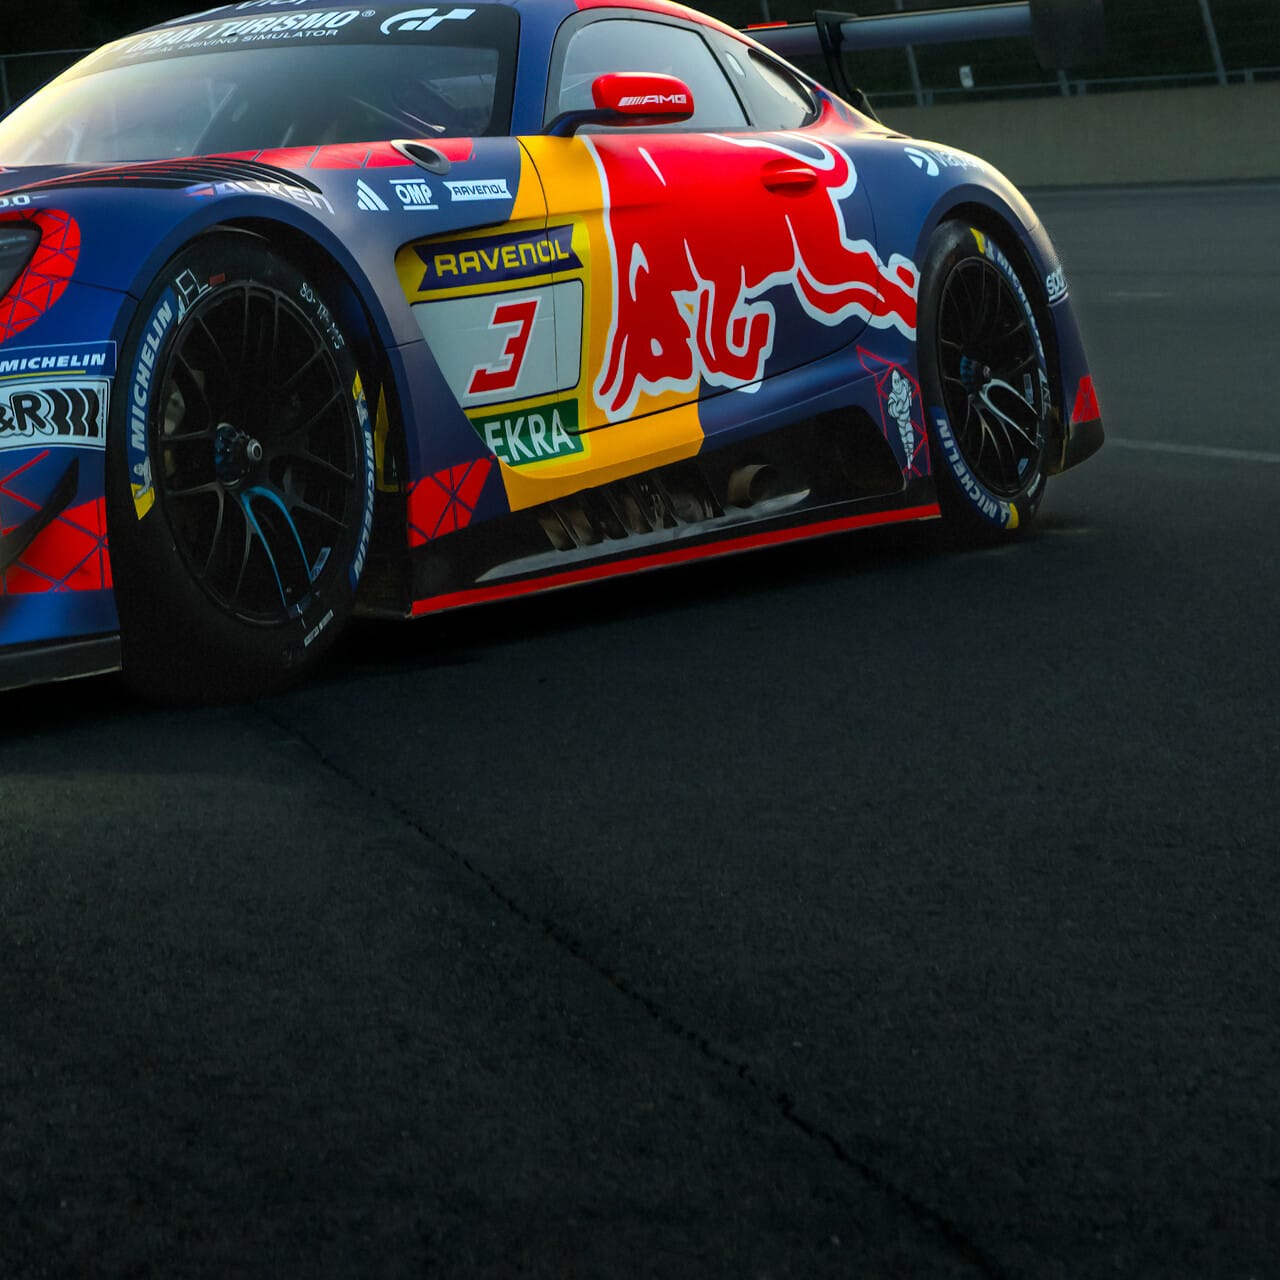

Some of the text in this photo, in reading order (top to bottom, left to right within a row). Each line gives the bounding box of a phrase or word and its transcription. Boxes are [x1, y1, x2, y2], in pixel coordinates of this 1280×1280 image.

[241, 29, 339, 44] SIMULATOR
[395, 184, 433, 205] OMP
[452, 184, 507, 197] RAVENOL
[434, 239, 570, 278] RAVENOL
[0, 352, 107, 374] MICHELIN
[465, 298, 540, 395] 3
[131, 300, 174, 452] MICHELIN
[484, 408, 576, 463] EKRA
[936, 419, 998, 519] MICHELIN
